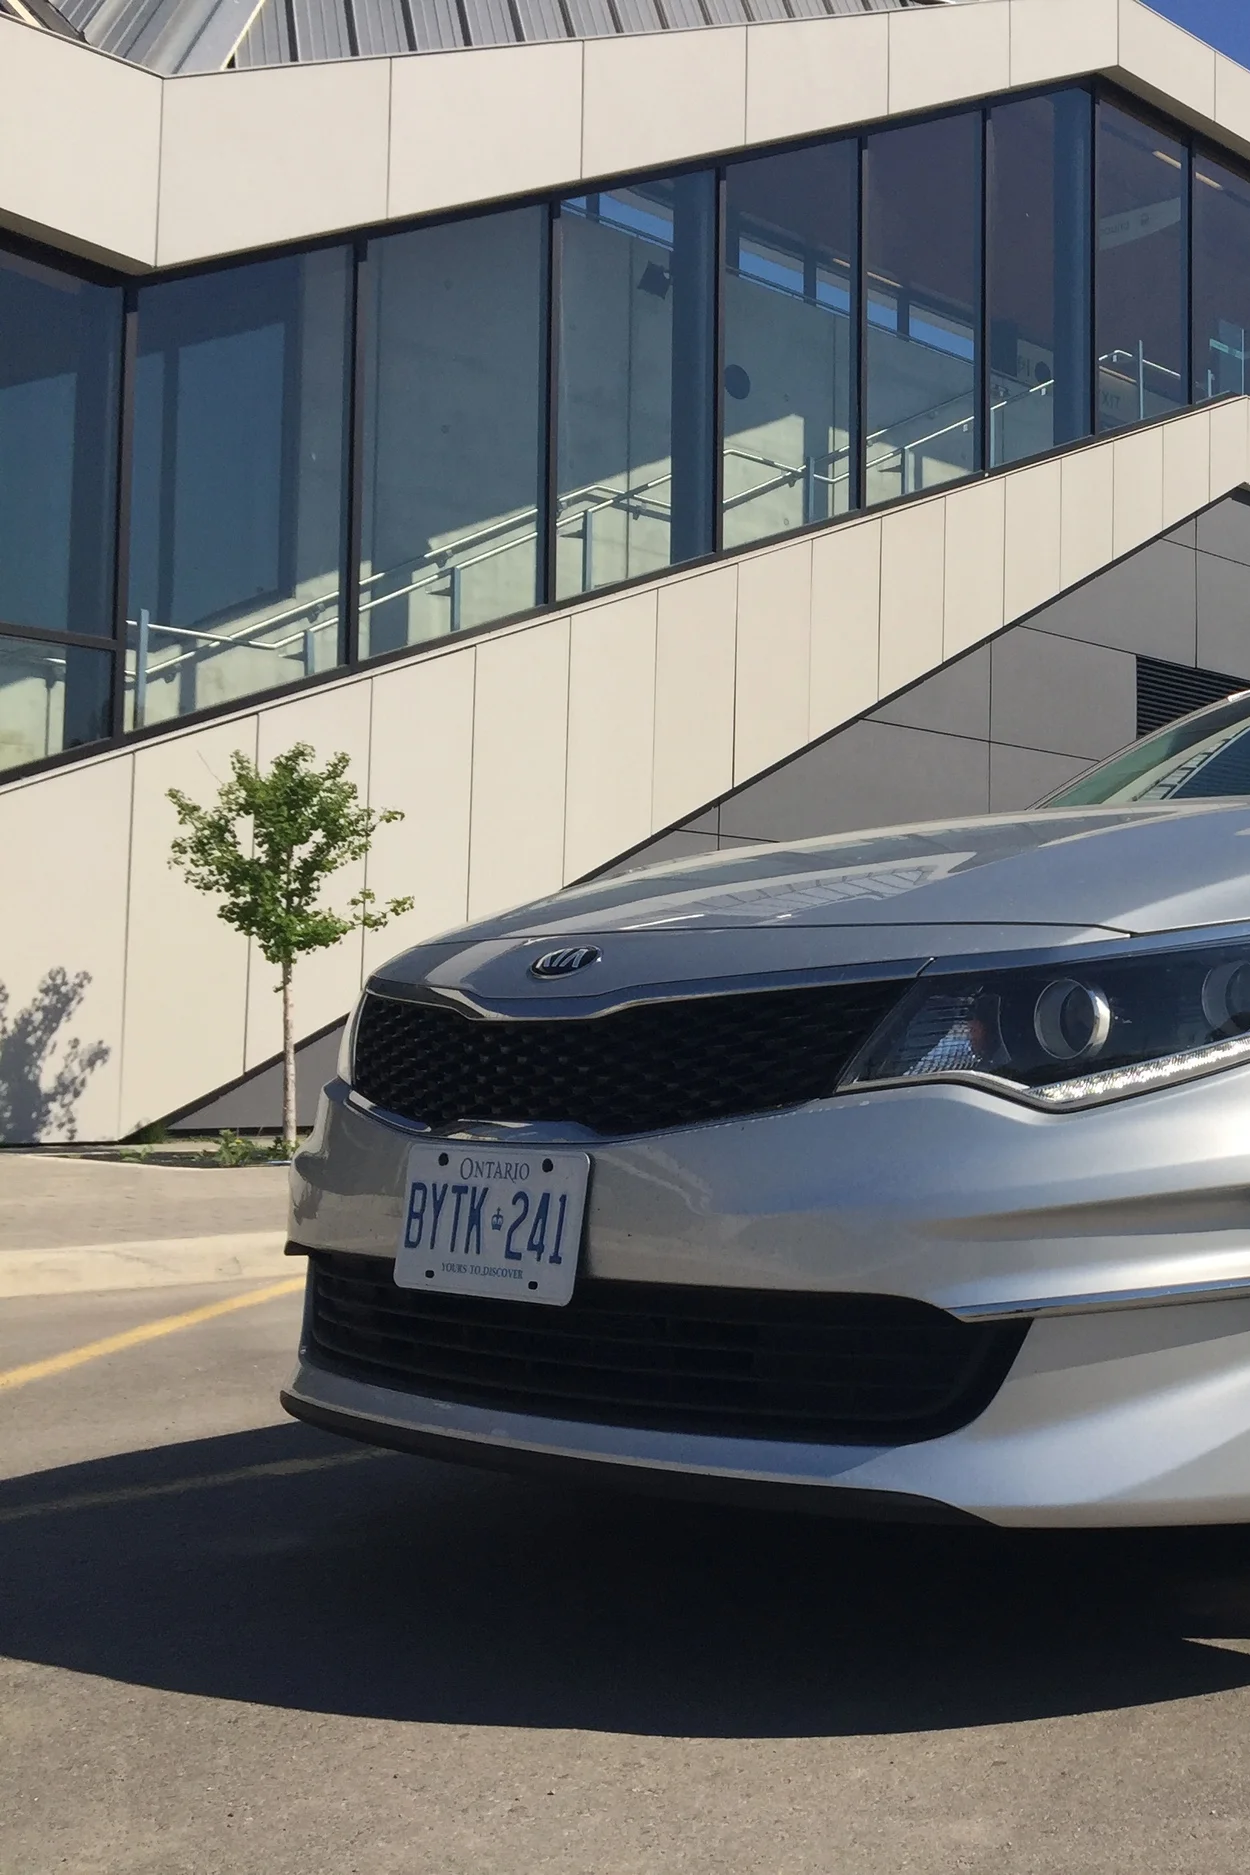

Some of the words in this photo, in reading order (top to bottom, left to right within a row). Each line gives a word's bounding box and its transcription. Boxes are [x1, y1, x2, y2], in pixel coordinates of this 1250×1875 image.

[536, 948, 589, 968] KIA
[404, 1181, 489, 1255] BYTK
[504, 1190, 567, 1265] 241
[441, 1262, 467, 1274] YOURS
[470, 1265, 481, 1275] TO
[483, 1266, 523, 1279] DISCOVER
